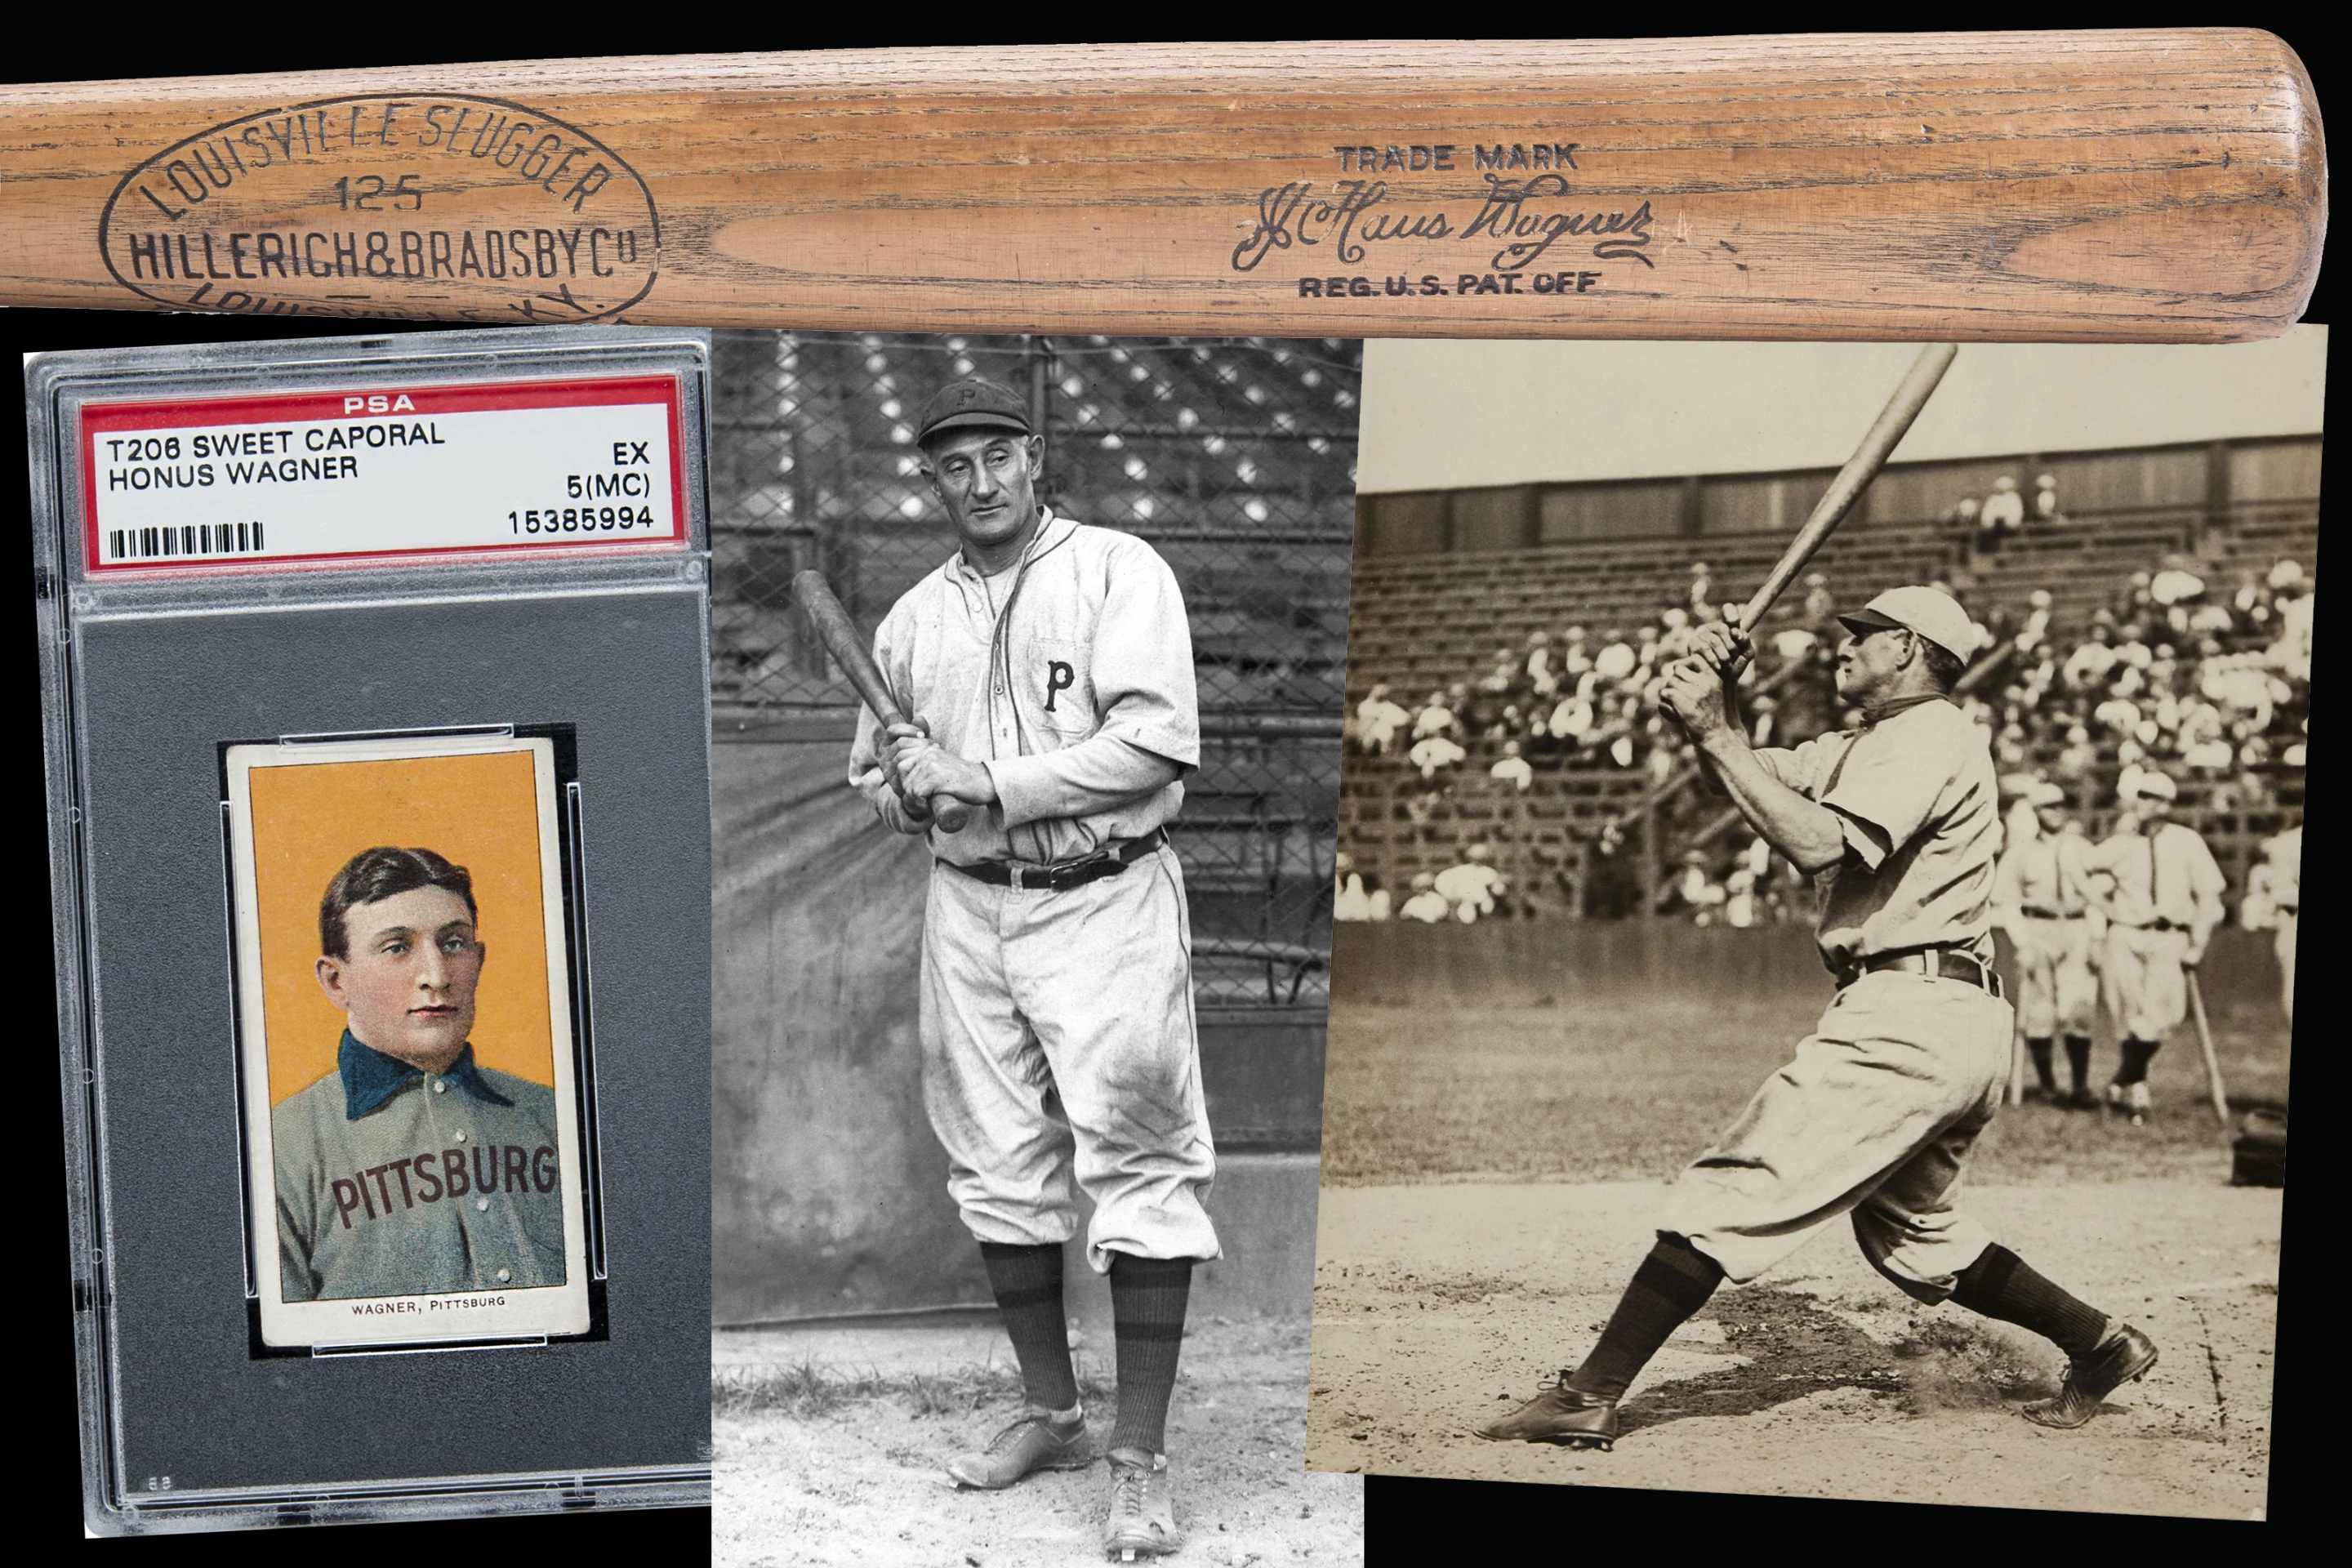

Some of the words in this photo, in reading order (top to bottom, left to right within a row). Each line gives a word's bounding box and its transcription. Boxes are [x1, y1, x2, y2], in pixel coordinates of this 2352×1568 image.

[140, 100, 414, 222] LOUISVILLE
[417, 105, 611, 215] SLUGGER
[1333, 145, 1456, 172] TRADE
[1474, 143, 1579, 171] MARK
[334, 174, 422, 212] 125
[1533, 270, 1602, 293] OFF
[344, 394, 416, 415] PSA
[107, 437, 180, 461] T206
[194, 431, 291, 459] SWEET
[305, 422, 445, 452] CAPORAL
[613, 442, 650, 466] EX
[109, 464, 214, 492] HONUS
[228, 456, 358, 485] WAGNER
[568, 473, 650, 501] 5(MC)
[509, 506, 654, 534] 15385994
[1044, 660, 1075, 712] P
[332, 1145, 558, 1230] PITTSBURG
[352, 1301, 422, 1315] WAGNER,
